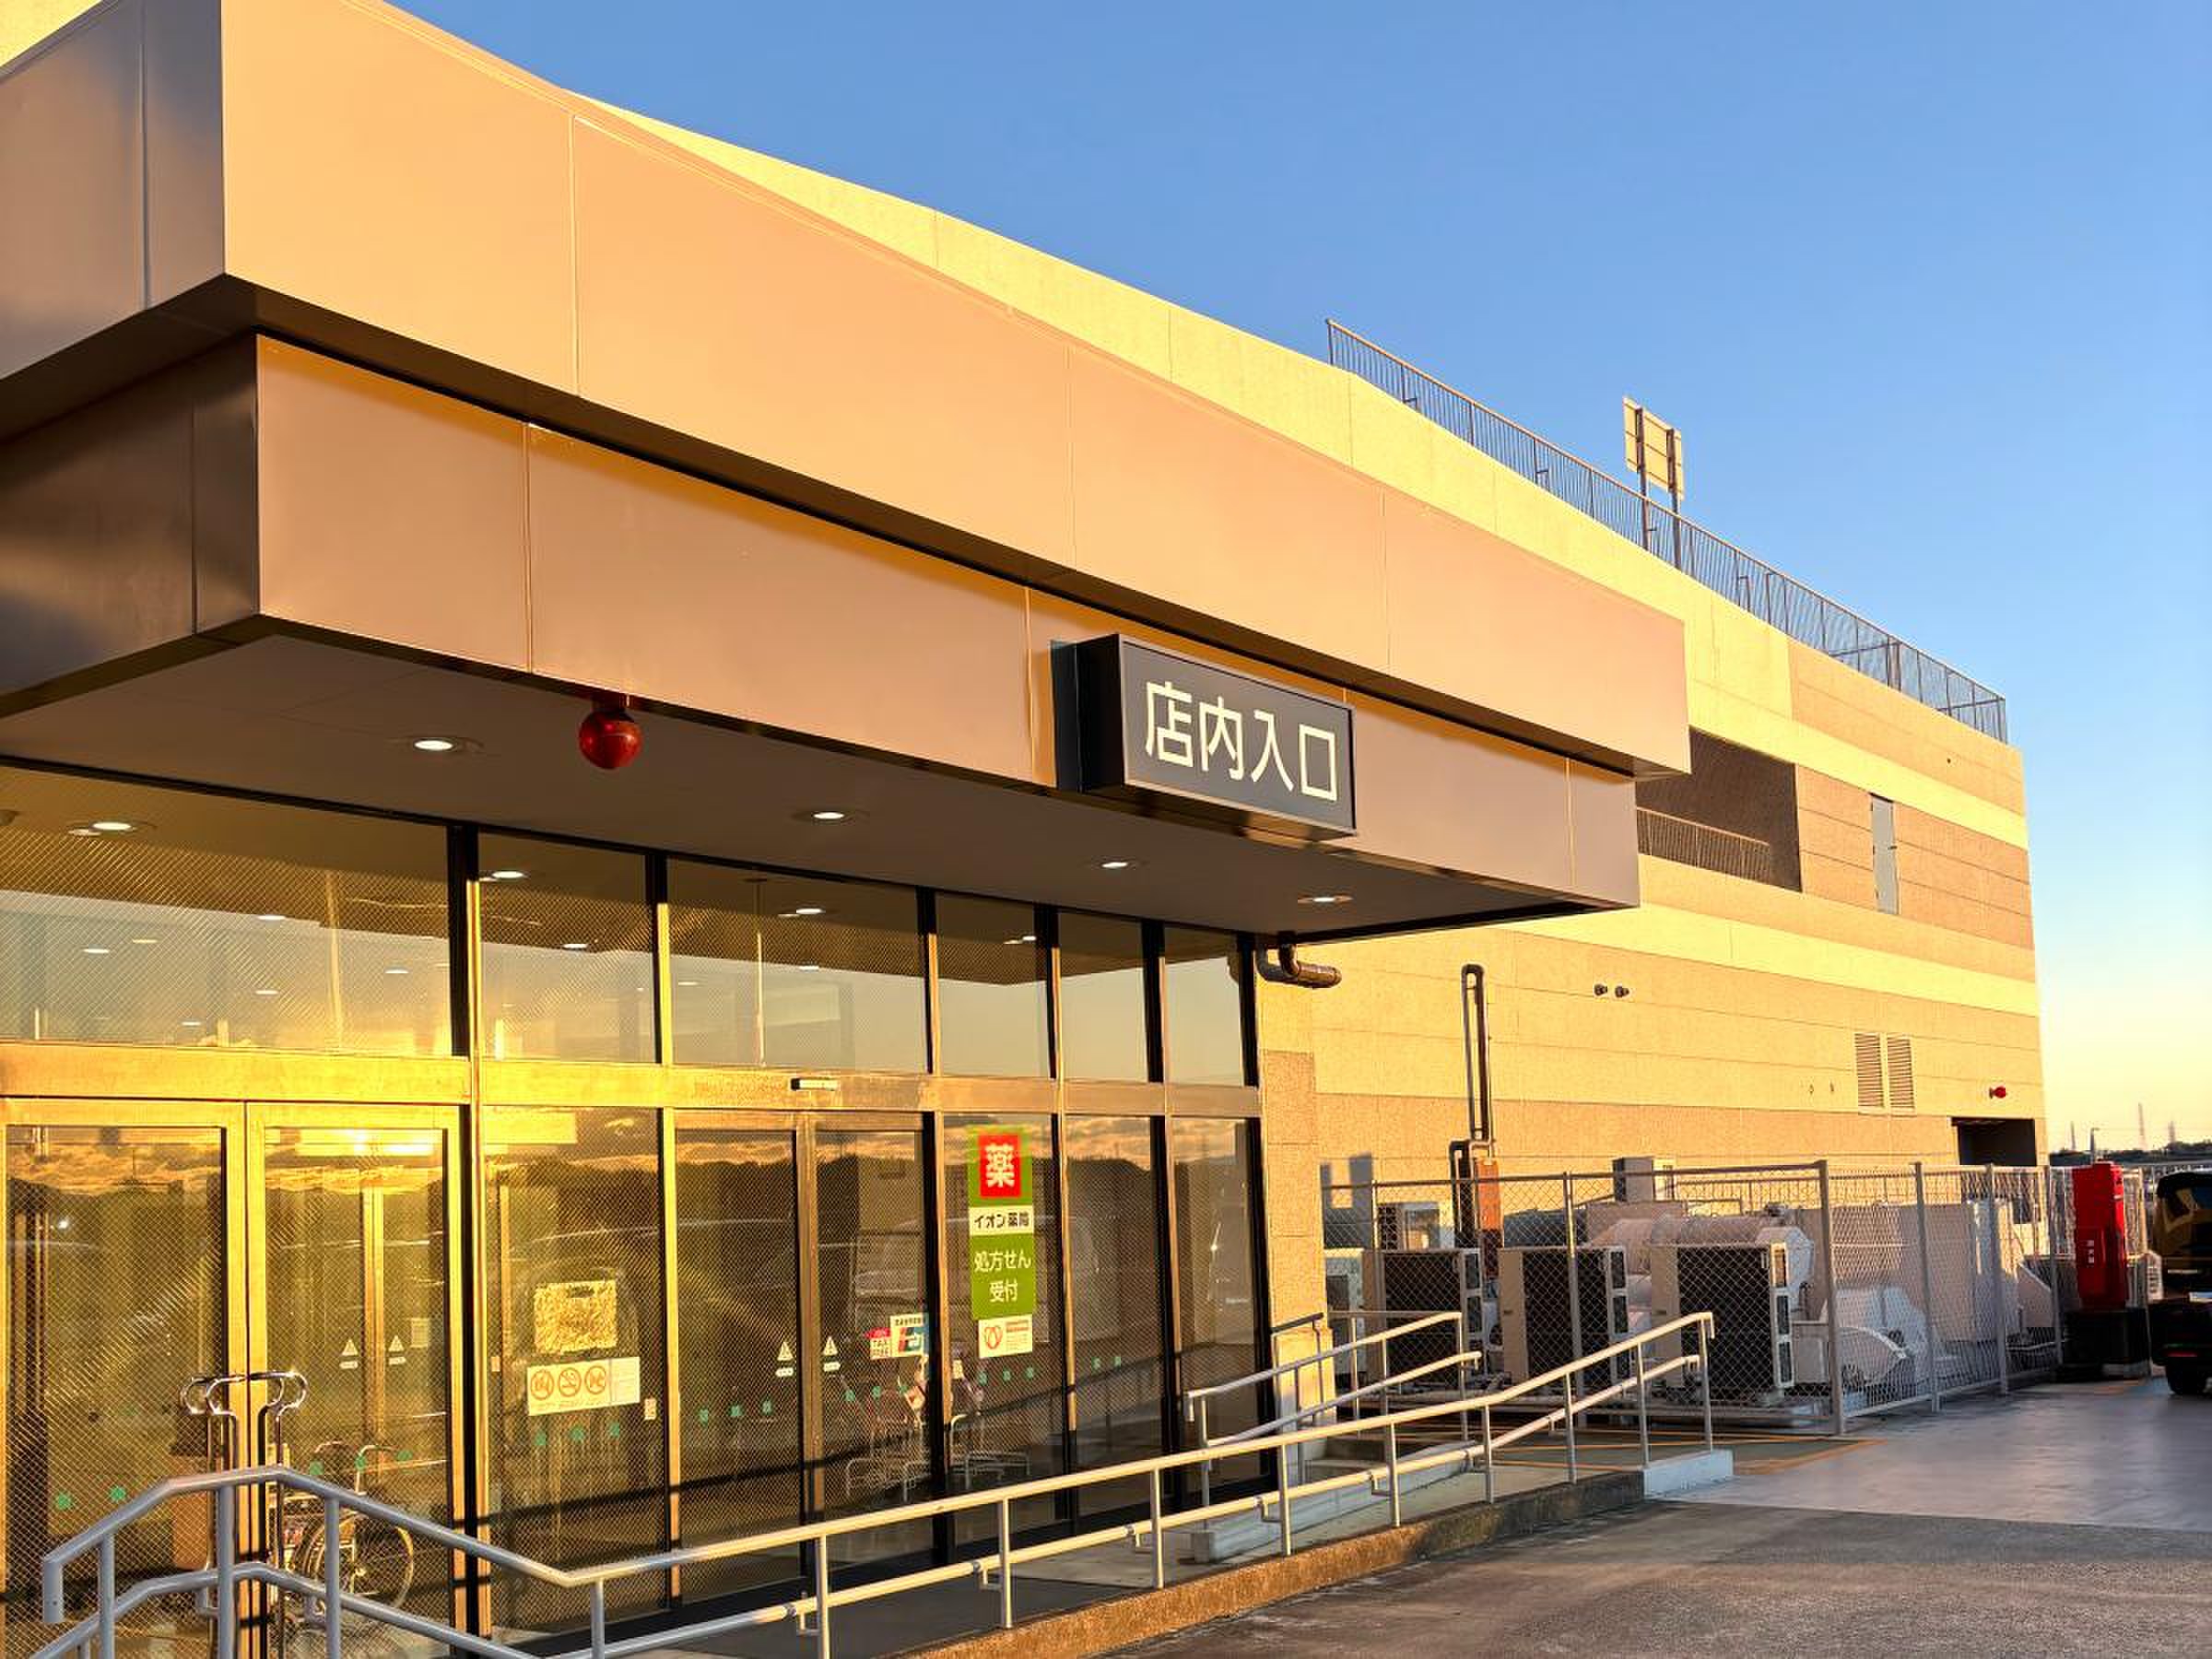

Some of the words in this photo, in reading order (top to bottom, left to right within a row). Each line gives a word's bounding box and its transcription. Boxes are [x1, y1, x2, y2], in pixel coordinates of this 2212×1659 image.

[1146, 681, 1337, 801] 店内入口
[985, 1143, 1015, 1189] 薬
[974, 1249, 1031, 1273] 処方せん
[989, 1278, 1018, 1302] 受付
